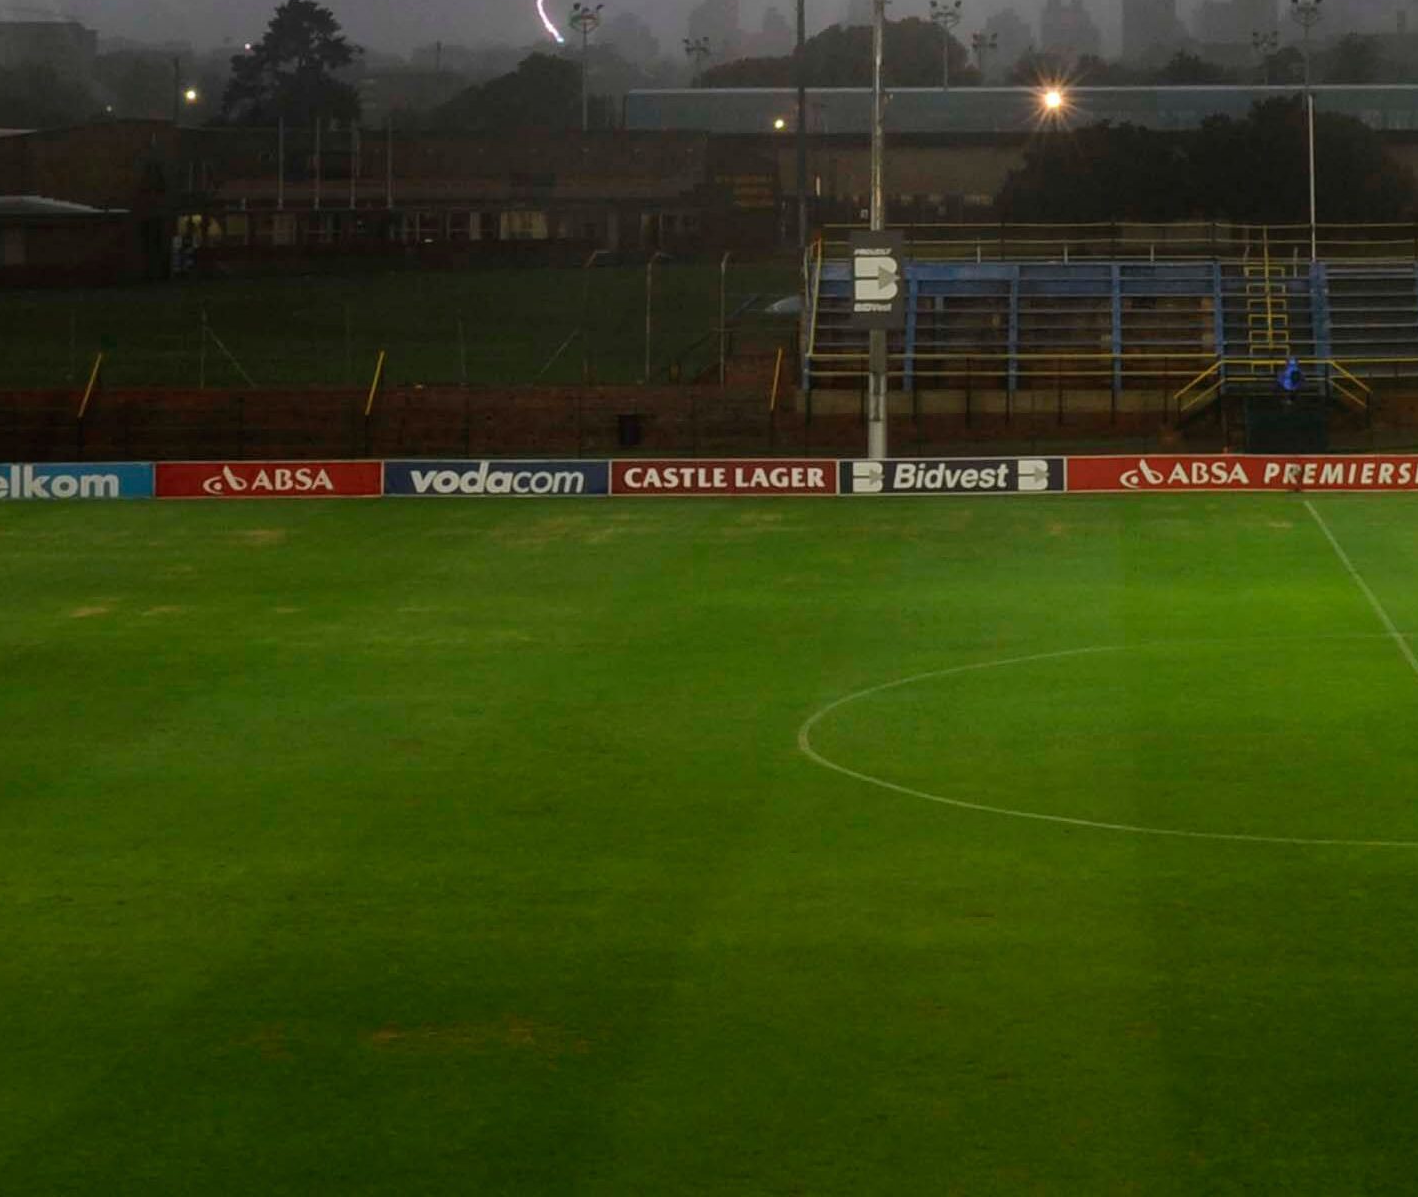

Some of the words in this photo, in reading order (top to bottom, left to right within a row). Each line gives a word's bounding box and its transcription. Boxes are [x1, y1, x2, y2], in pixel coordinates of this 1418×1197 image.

[250, 468, 334, 492] ABSA
[410, 461, 585, 495] vodacom
[623, 466, 727, 489] CASTLE
[734, 467, 827, 489] LAGER
[892, 463, 1009, 490] Bidvest
[1167, 461, 1249, 485] ABSA
